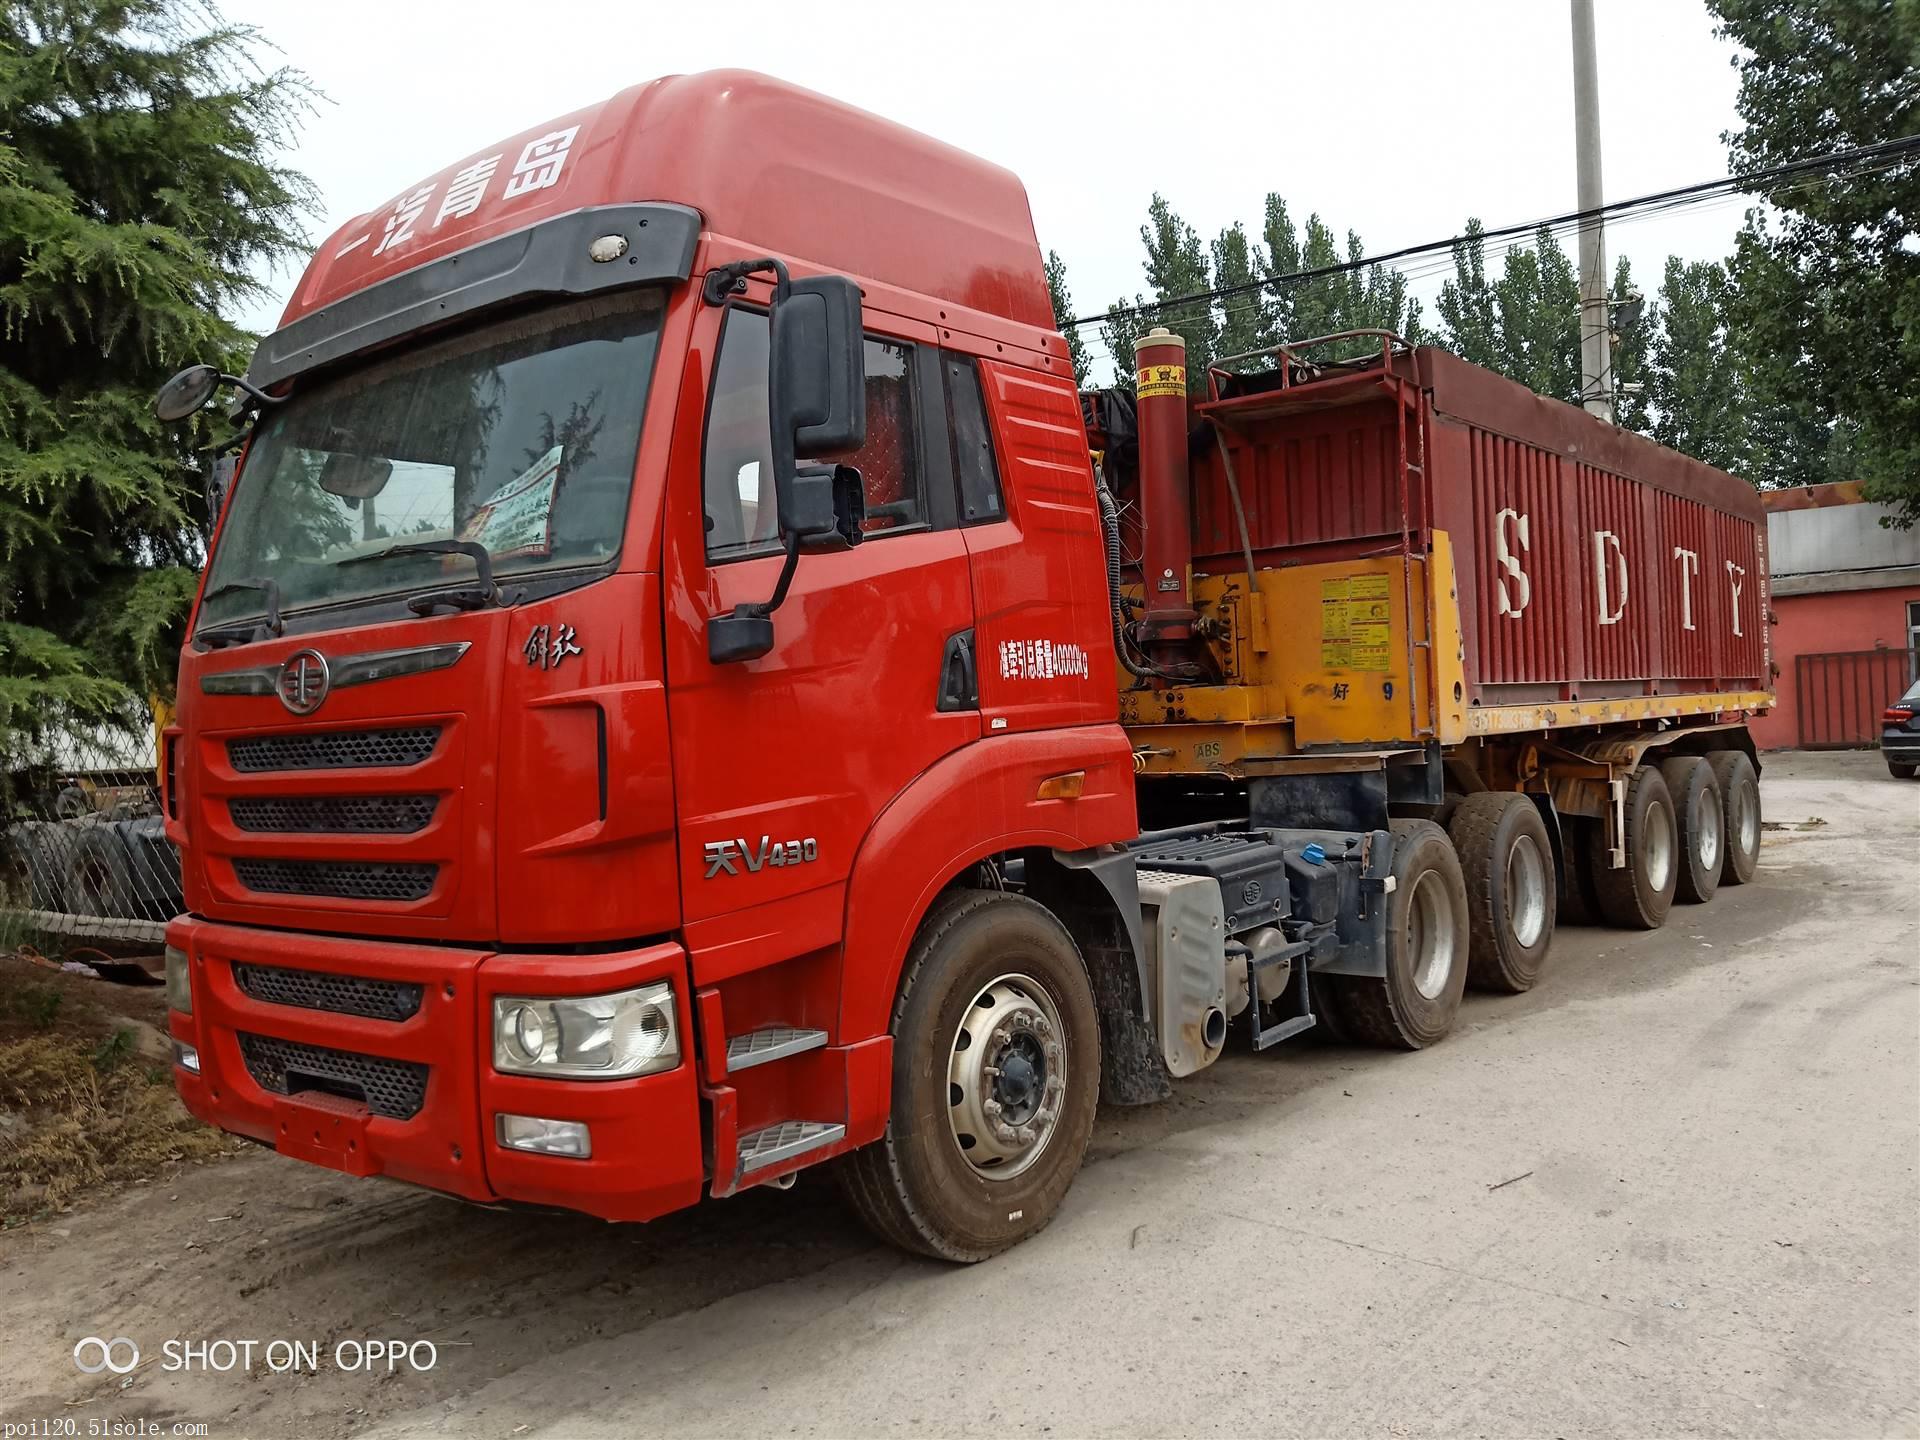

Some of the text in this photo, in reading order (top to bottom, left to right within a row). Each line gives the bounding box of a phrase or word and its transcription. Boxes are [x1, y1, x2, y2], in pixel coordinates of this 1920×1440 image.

[335, 124, 581, 260] 一汽青岛
[1197, 743, 1220, 759] ABS
